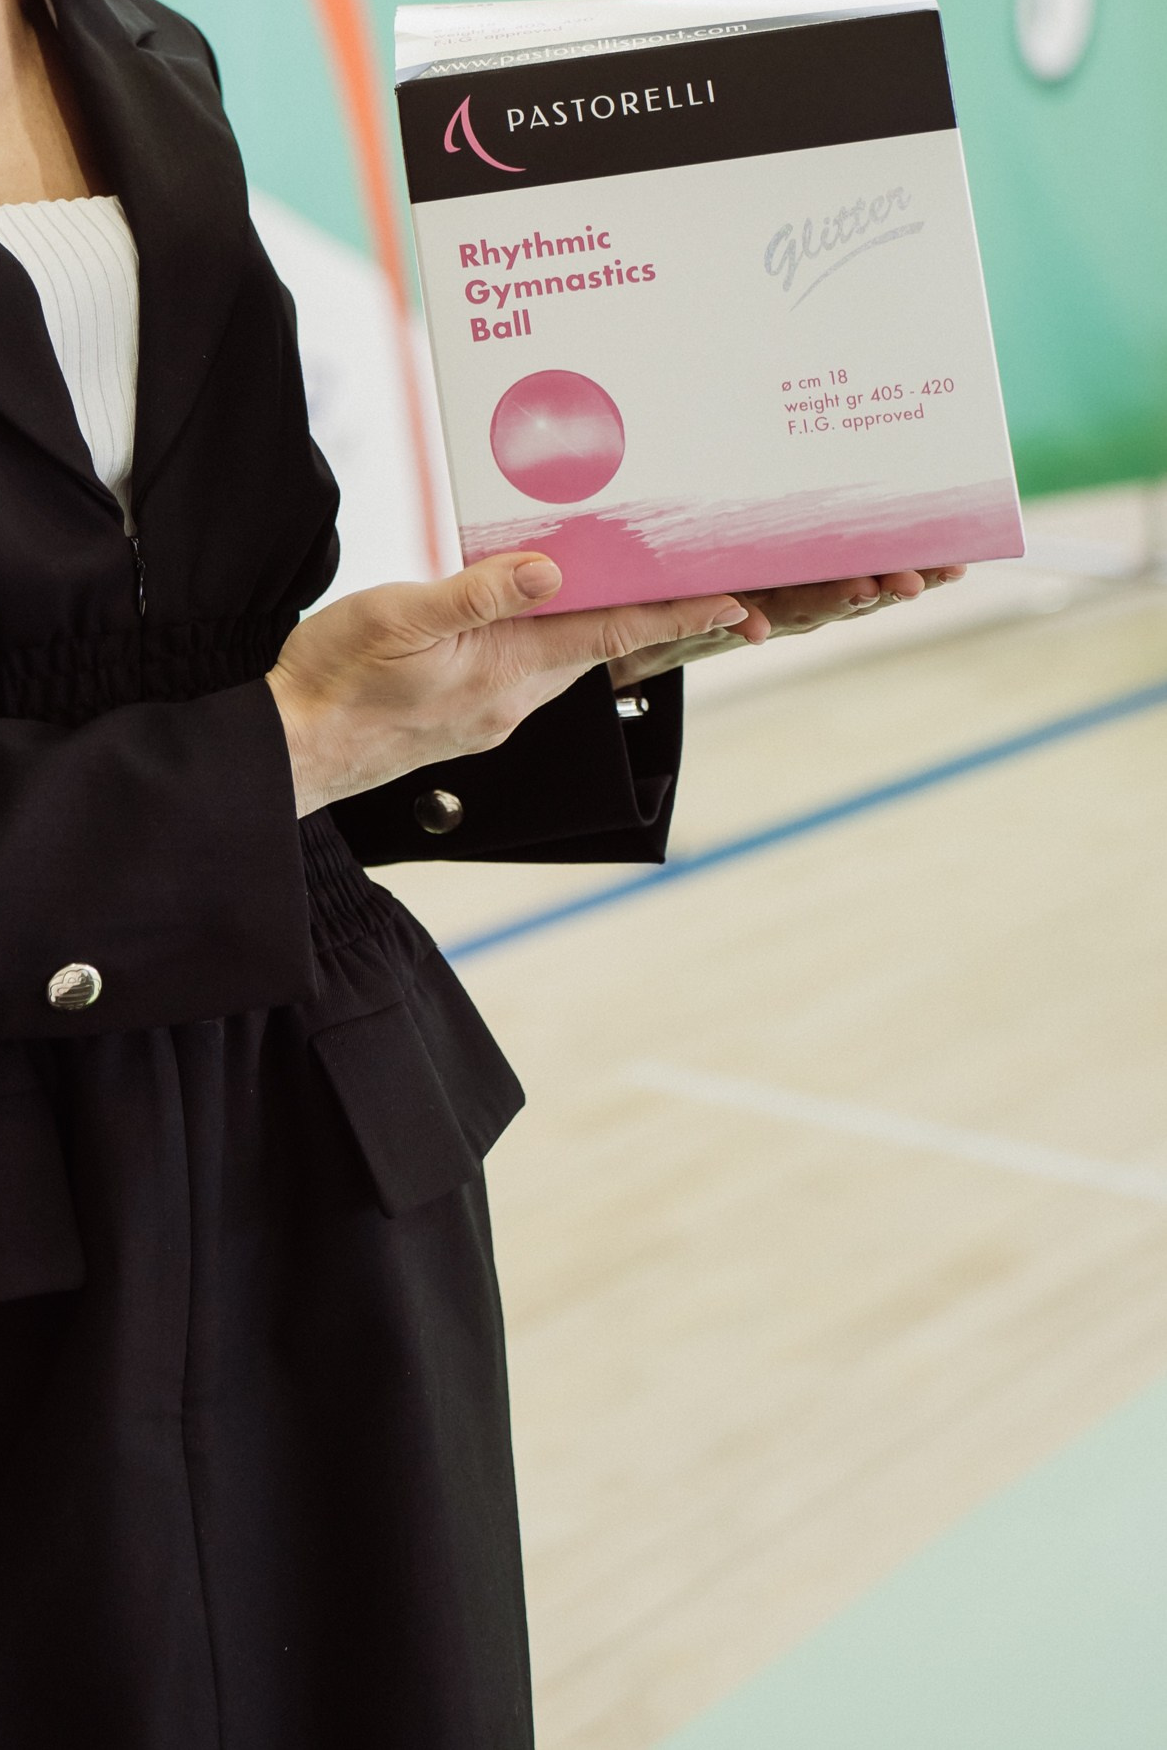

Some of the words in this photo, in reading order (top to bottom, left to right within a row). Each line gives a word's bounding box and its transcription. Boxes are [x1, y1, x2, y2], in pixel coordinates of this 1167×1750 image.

[431, 23, 748, 74] www.pastorellisport.com
[484, 25, 563, 41] approved
[506, 79, 716, 132] PASTORELLI
[458, 225, 611, 271] Rhythmic
[763, 186, 912, 293] Glitter
[464, 259, 656, 310] Gymnastics
[470, 308, 532, 342] Ball
[784, 392, 840, 414] weight
[846, 393, 864, 410] gr
[870, 384, 904, 402] 405
[921, 377, 955, 396] 420
[798, 377, 821, 390] cm
[828, 369, 848, 386] 18
[787, 416, 835, 435] F.I.G.
[842, 402, 925, 432] approved
